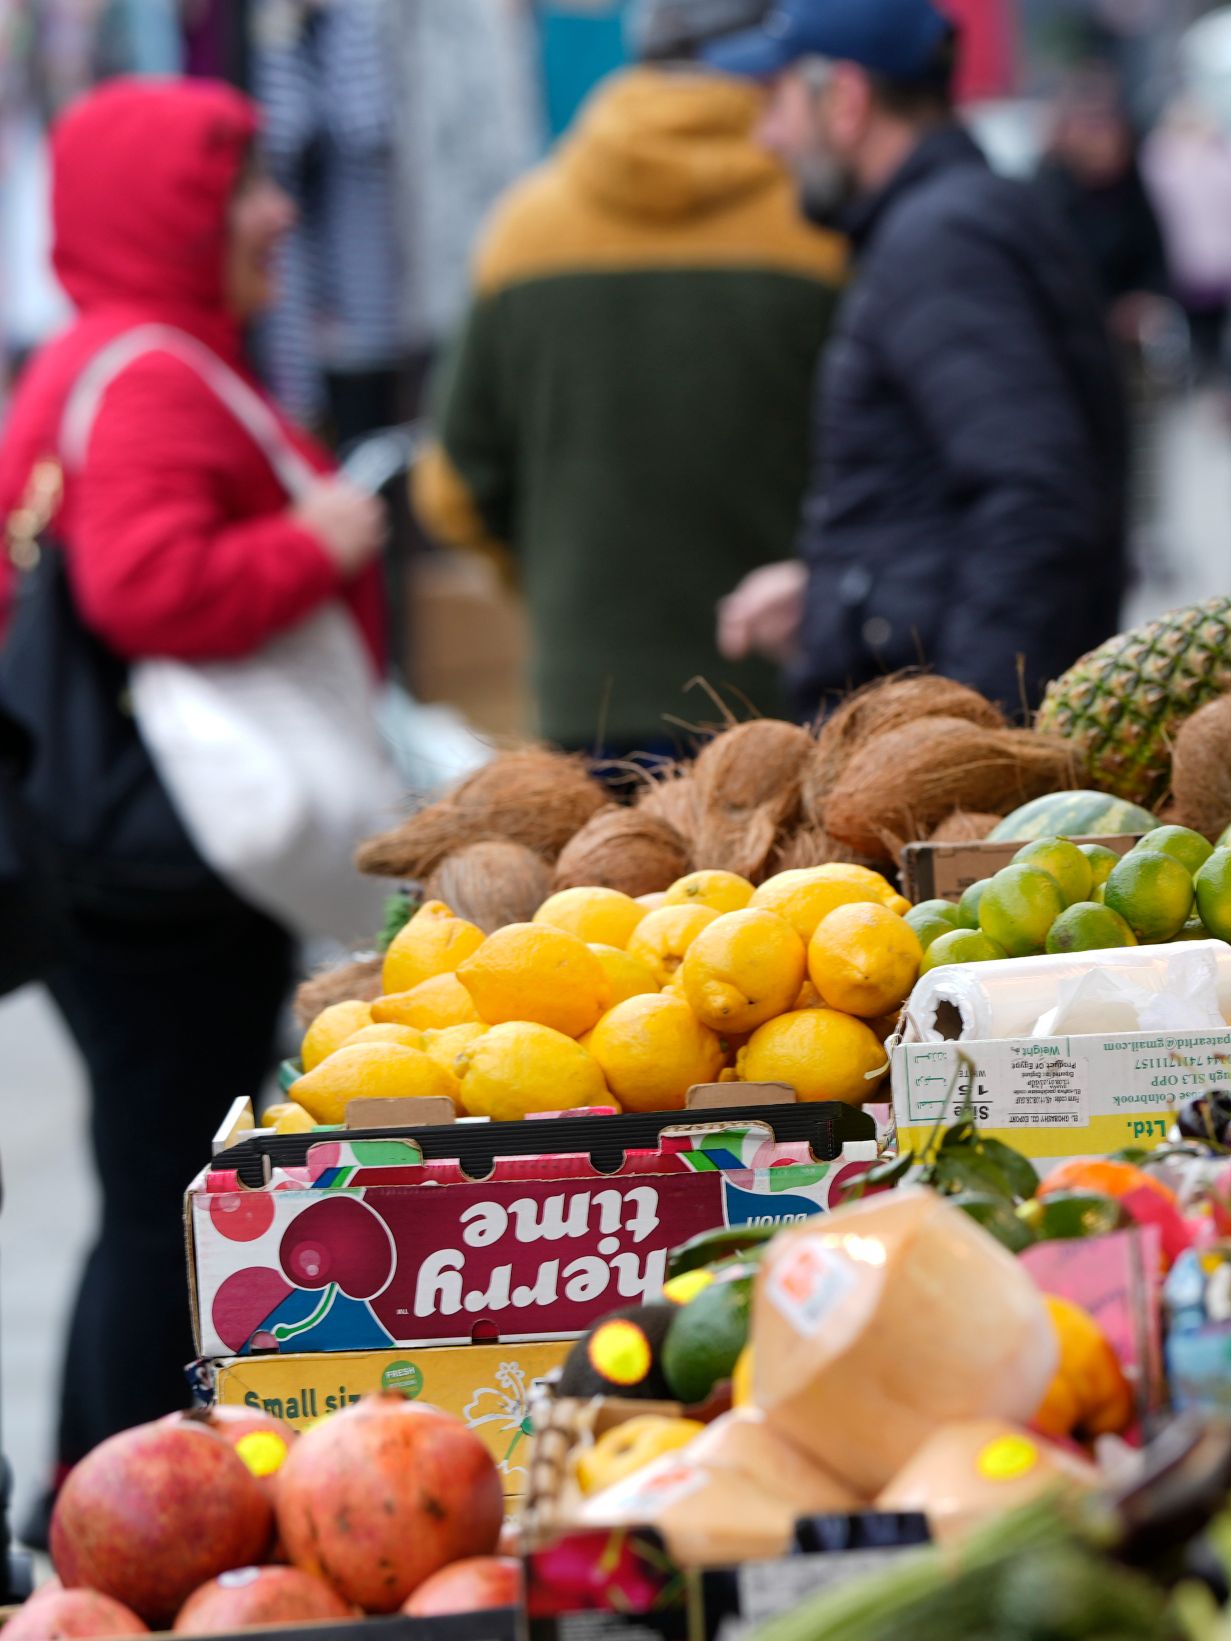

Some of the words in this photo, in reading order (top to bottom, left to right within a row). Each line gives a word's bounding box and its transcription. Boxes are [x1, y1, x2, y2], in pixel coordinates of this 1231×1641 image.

[1022, 1045, 1060, 1056] Weight
[1010, 1061, 1033, 1070] Egypt
[1036, 1062, 1044, 1070] Of
[1046, 1062, 1076, 1070] Product
[1182, 1074, 1206, 1084] SL3
[958, 1084, 988, 1096] 15
[954, 1106, 988, 1120] Sie
[1127, 1120, 1166, 1138] Ltd.
[460, 1186, 660, 1255] time
[244, 1388, 318, 1420] Small
